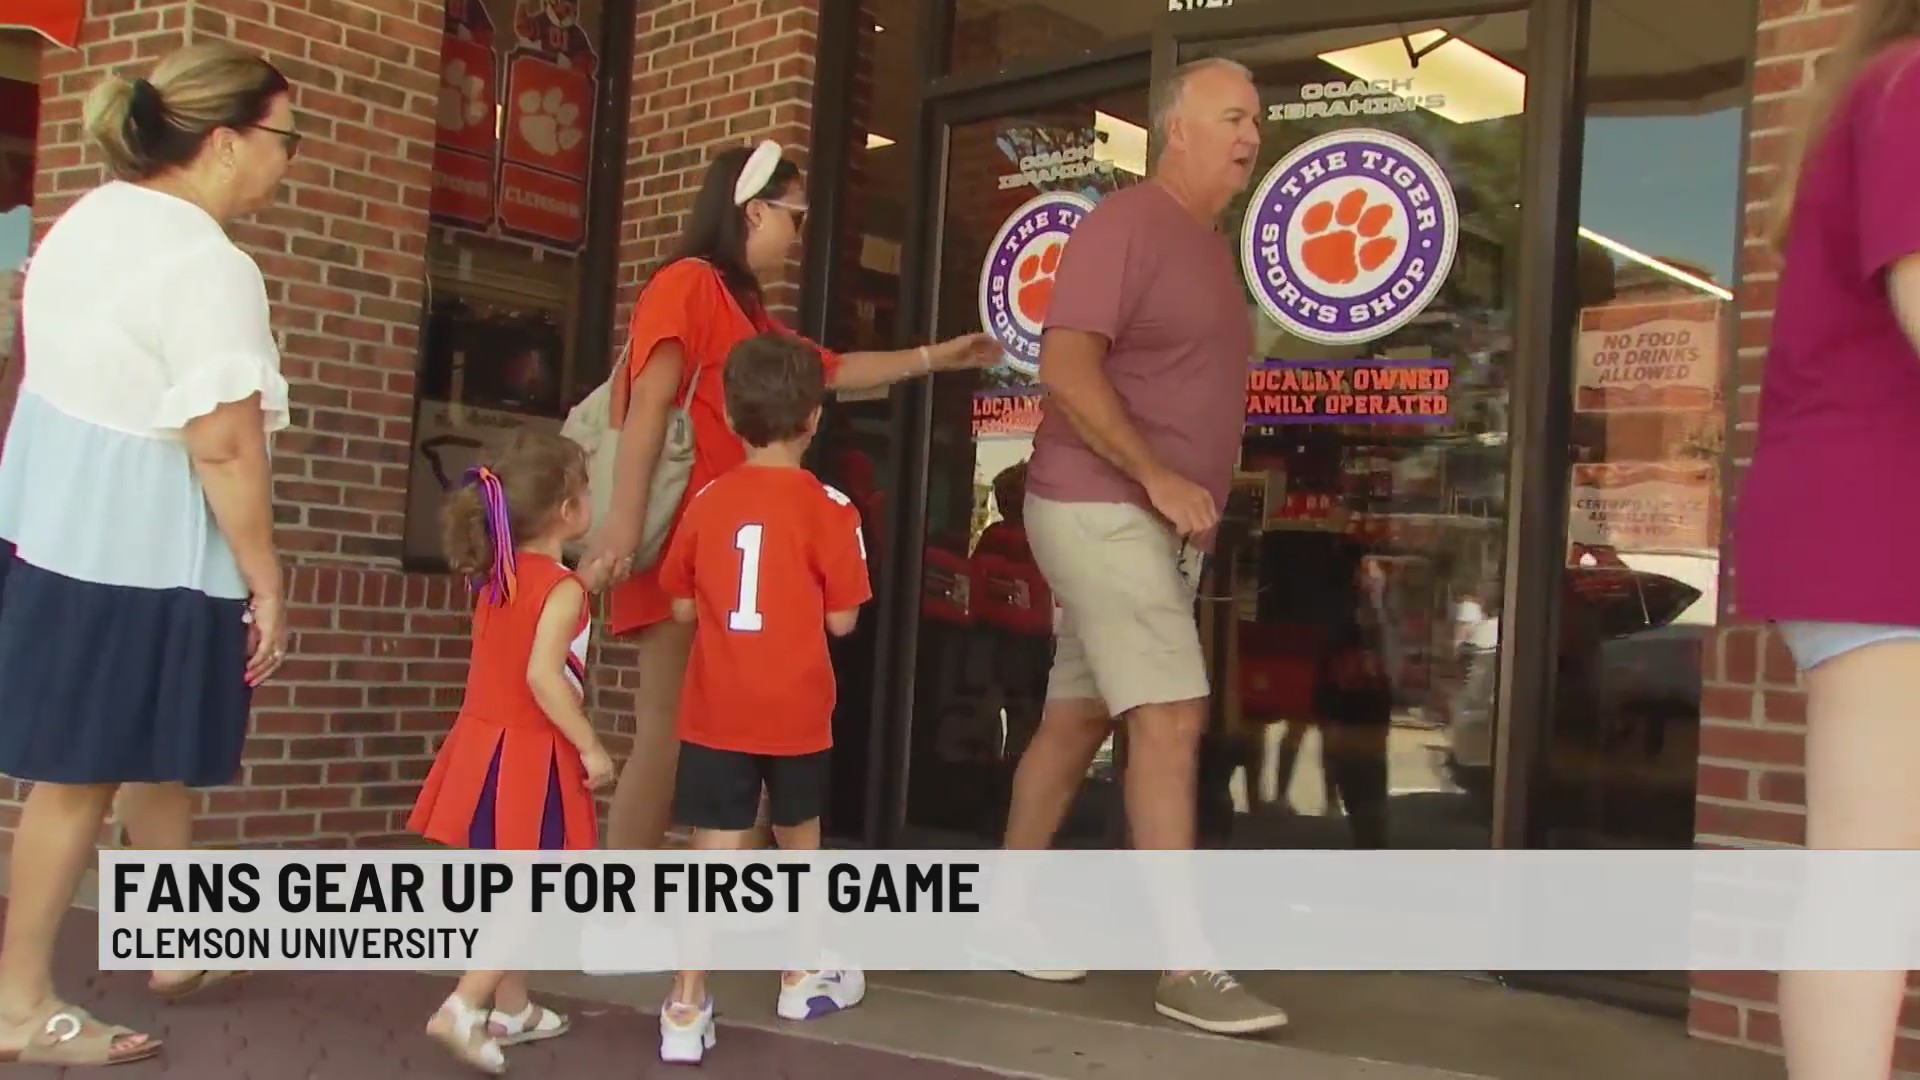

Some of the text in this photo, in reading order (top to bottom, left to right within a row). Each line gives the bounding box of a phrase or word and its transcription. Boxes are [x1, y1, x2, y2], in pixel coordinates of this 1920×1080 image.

[1301, 78, 1413, 101] COACH
[1268, 94, 1446, 121] IBRAHIM'S
[1280, 150, 1437, 232] THE TIGER
[1005, 211, 1050, 253] THE
[1261, 222, 1427, 324] SPORTS SHOP
[992, 275, 1041, 357] SPORTS
[1603, 329, 1690, 349] NO FOOD
[1593, 347, 1700, 367] OR DRINKS
[1246, 368, 1449, 391] OCALLY OWNED
[1599, 365, 1690, 382] ALLOWED
[1247, 395, 1448, 414] AMILY OPERATED
[728, 523, 764, 631] 1
